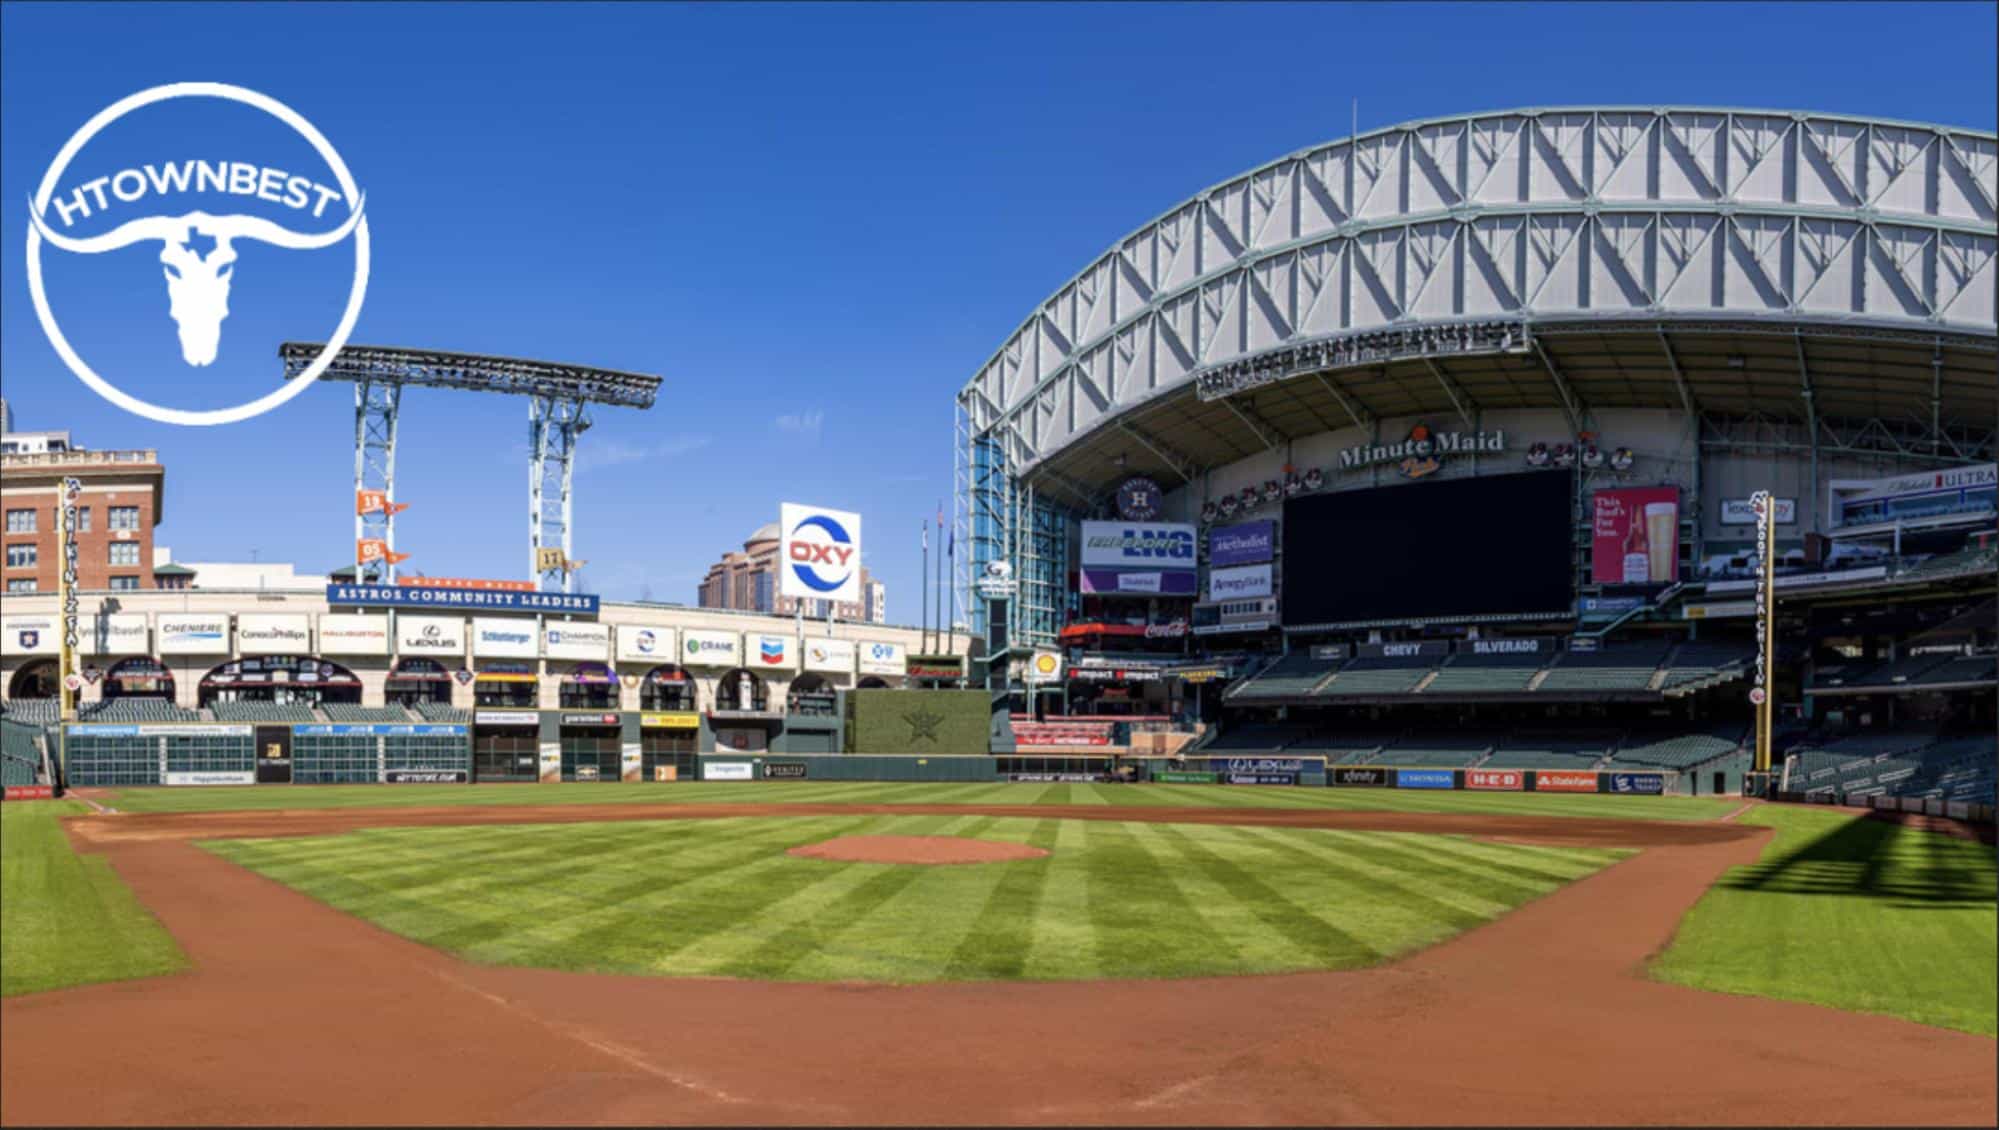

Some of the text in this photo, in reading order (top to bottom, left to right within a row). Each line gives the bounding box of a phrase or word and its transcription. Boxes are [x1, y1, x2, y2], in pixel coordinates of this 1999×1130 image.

[1338, 430, 1504, 469] Minute Maid
[1944, 470, 1996, 486] ULTRA
[1596, 497, 1621, 507] This
[1123, 529, 1193, 558] LNG
[790, 541, 853, 566] OXY
[337, 588, 592, 609] ASTROS COMMUNITY LEADERS
[163, 623, 223, 633] CHENIERE
[241, 629, 306, 640] ConocoPhillips
[406, 639, 457, 648] LEXUS
[700, 640, 733, 652] CRANE
[1384, 640, 1538, 656] CHEVY SILVERADO
[1343, 769, 1377, 784] xfinity
